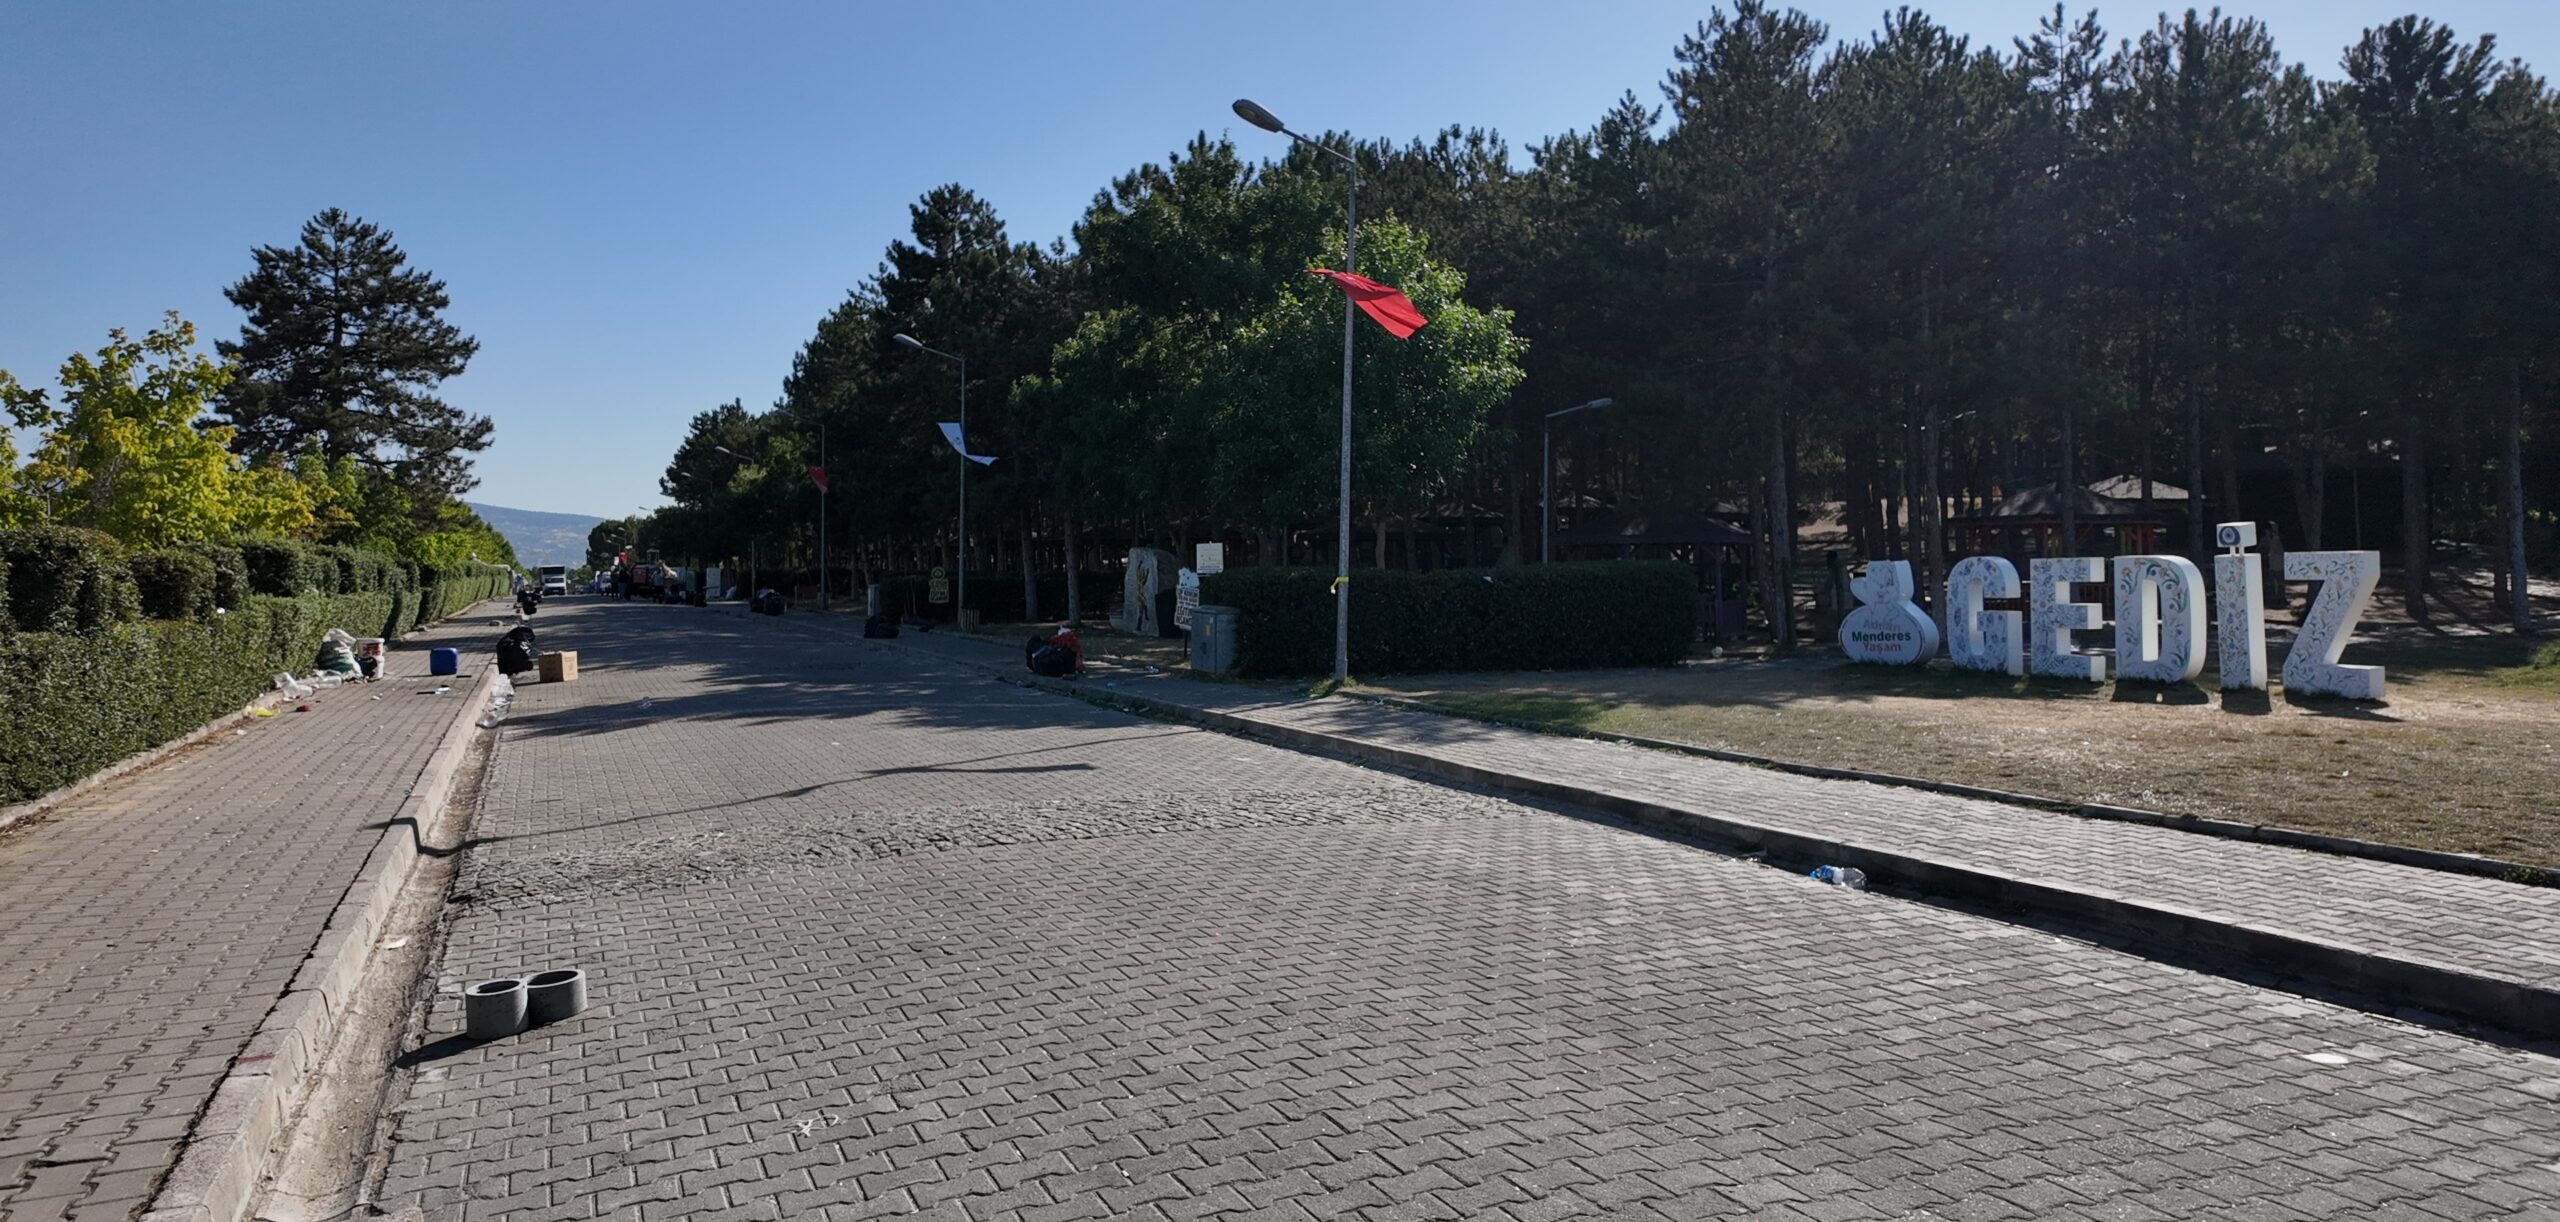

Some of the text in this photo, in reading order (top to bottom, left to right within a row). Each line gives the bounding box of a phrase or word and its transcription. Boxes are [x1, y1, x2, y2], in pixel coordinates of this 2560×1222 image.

[1946, 521, 2385, 699] GEDİZ
[1852, 631, 1912, 642] Menderes
[1863, 641, 1901, 654] Yaşam
